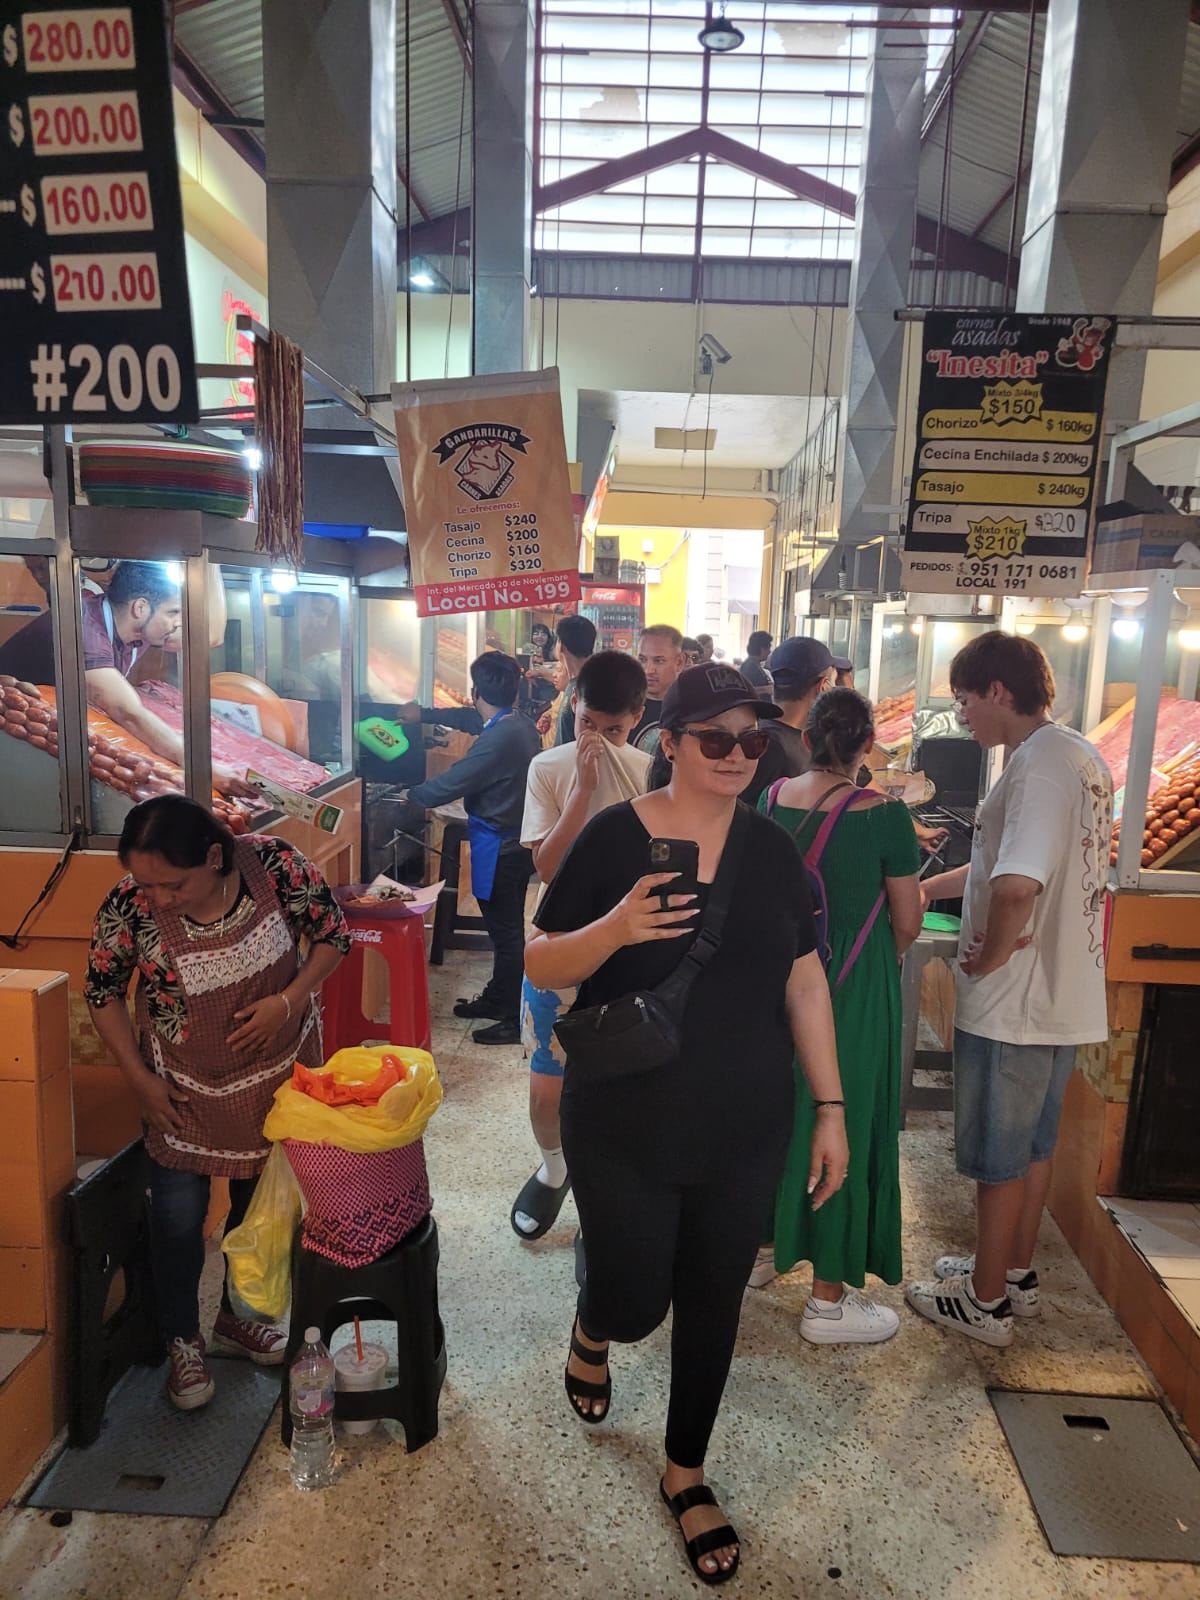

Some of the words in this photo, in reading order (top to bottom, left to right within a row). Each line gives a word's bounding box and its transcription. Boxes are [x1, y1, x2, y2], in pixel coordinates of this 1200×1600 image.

[3, 22, 17, 66] $
[27, 19, 131, 63] 280.00
[9, 104, 24, 147] $
[33, 102, 138, 146] 200.00
[21, 184, 36, 226] $
[46, 181, 147, 225] 160.00
[31, 262, 45, 303] $
[952, 318, 1021, 346] asadas
[31, 343, 181, 412] #200
[988, 389, 1012, 397] Mixto
[989, 399, 1036, 416] $150
[926, 418, 978, 429] Chorizo
[1058, 421, 1092, 434] 160kg
[445, 428, 518, 449] GANDARILLAS
[924, 449, 970, 461] Cecina
[974, 449, 1039, 463] Enchilada
[1053, 452, 1089, 466] 200kg
[920, 480, 964, 493] Tasajo
[1049, 484, 1085, 498] 240kg
[470, 502, 520, 513] ofrecemos:
[444, 521, 480, 533] Tasajo
[505, 514, 536, 527] $240
[918, 512, 952, 525] Tripa
[446, 537, 484, 548] Cecina
[507, 529, 538, 542] $200
[974, 525, 1001, 535] Mixto
[1004, 526, 1021, 536] 1kg
[448, 551, 491, 563] Chorizo
[508, 544, 540, 557] $160
[974, 535, 1018, 553] $210
[450, 568, 478, 578] Tripa
[510, 558, 541, 571] $320
[910, 562, 954, 572] PEDIDOS:
[971, 563, 998, 577] 951
[1005, 564, 1032, 578] 171
[1039, 566, 1077, 579] 0681
[427, 588, 442, 596] Int.
[459, 582, 495, 592] Mercado
[498, 580, 508, 588] 20
[523, 574, 568, 585] Noviembre
[956, 577, 996, 588] LOCAL
[1004, 578, 1026, 589] 191
[427, 591, 486, 613] Local
[494, 589, 528, 606] No.
[535, 582, 570, 600] 199
